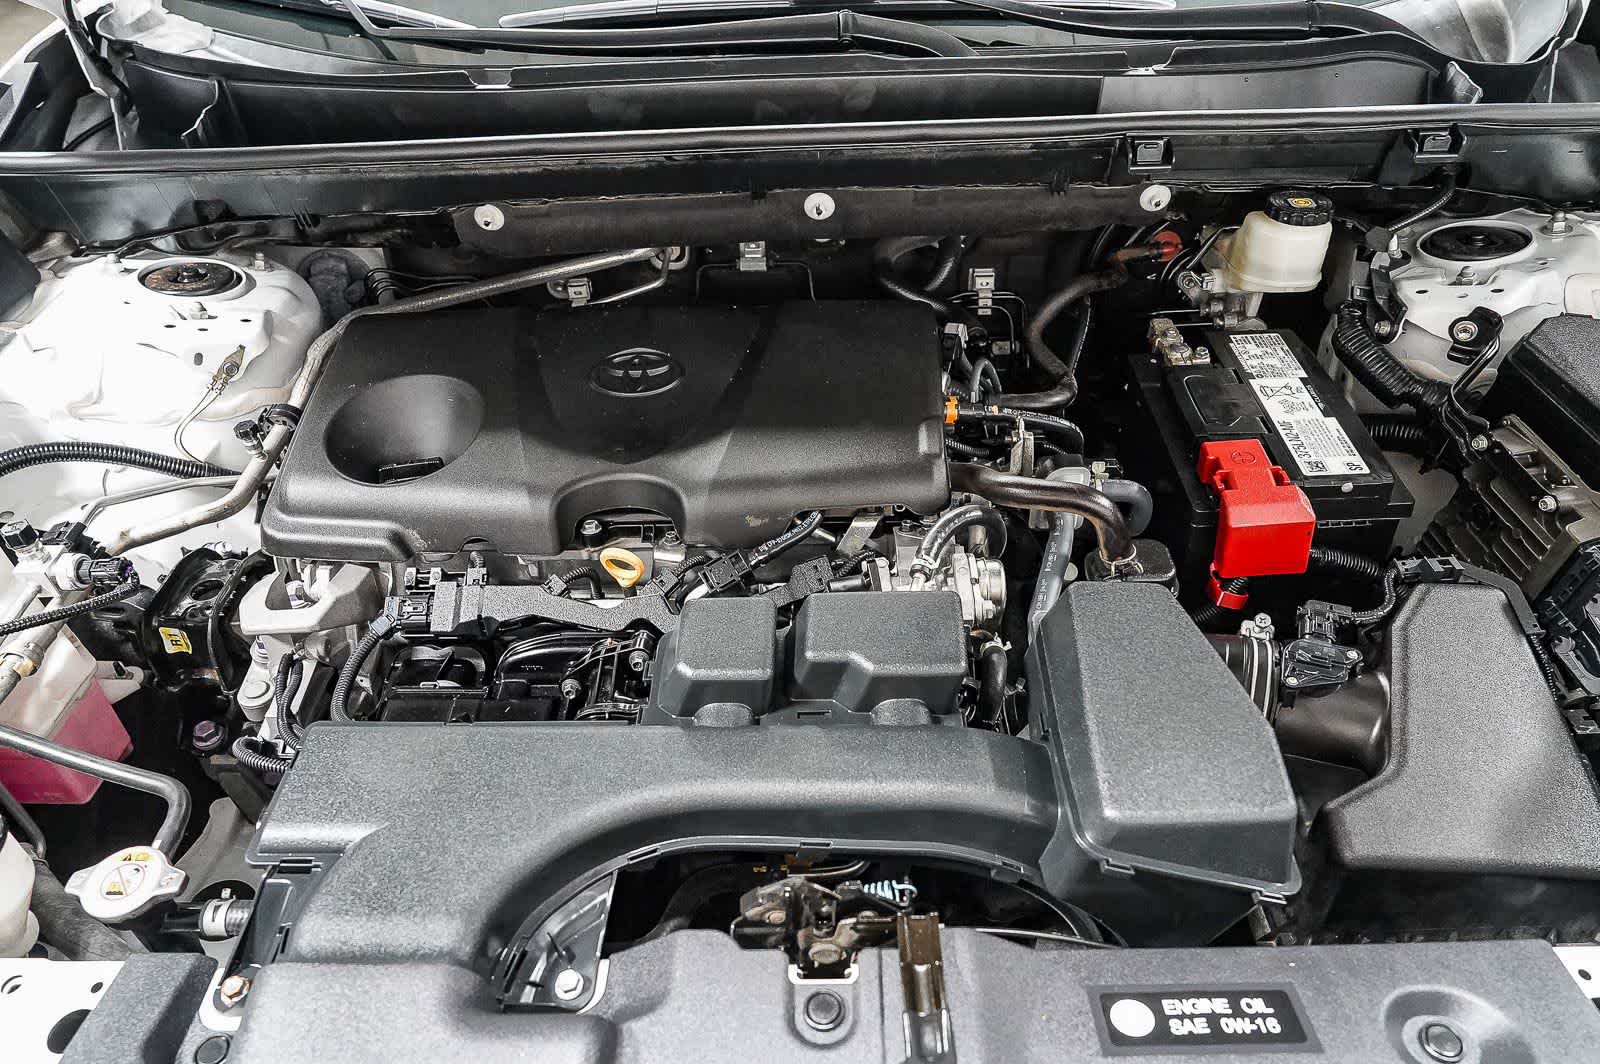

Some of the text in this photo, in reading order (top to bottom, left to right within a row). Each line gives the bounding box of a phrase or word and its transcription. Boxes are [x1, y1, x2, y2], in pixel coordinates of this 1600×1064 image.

[1348, 462, 1363, 471] SP
[1161, 998, 1275, 1015] ENGINE OIL
[1169, 1017, 1281, 1035] SAE 0W-16
